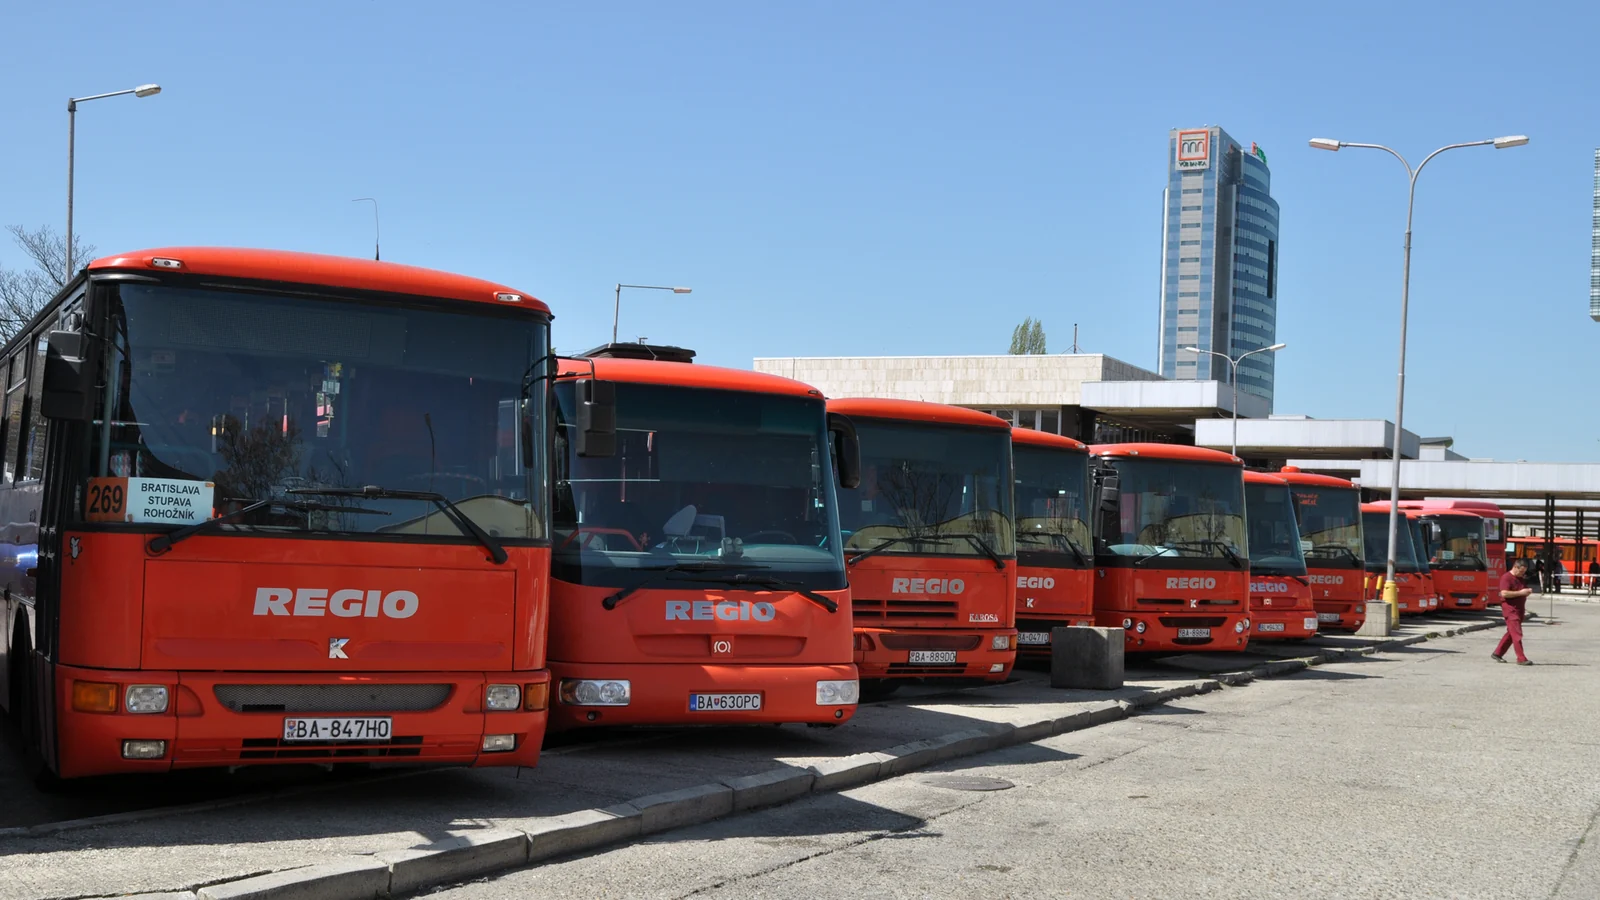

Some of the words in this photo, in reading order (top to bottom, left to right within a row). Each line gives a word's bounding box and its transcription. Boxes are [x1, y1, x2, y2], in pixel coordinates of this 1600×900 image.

[141, 483, 200, 495] BRATISLAVA
[89, 485, 123, 513] 269
[148, 496, 191, 507] STUPAVA
[143, 508, 194, 520] ROHOŽNÍK
[1016, 576, 1055, 589] EGIO
[1166, 577, 1216, 589] REGIO
[1308, 575, 1344, 584] REGIO
[892, 578, 965, 594] REGIO
[1250, 582, 1288, 592] REGIO
[253, 587, 419, 619] REGIO
[1026, 598, 1034, 608] K
[1190, 599, 1197, 608] K
[665, 600, 776, 622] REGIO
[969, 614, 998, 622] KAROSA
[328, 638, 350, 659] K
